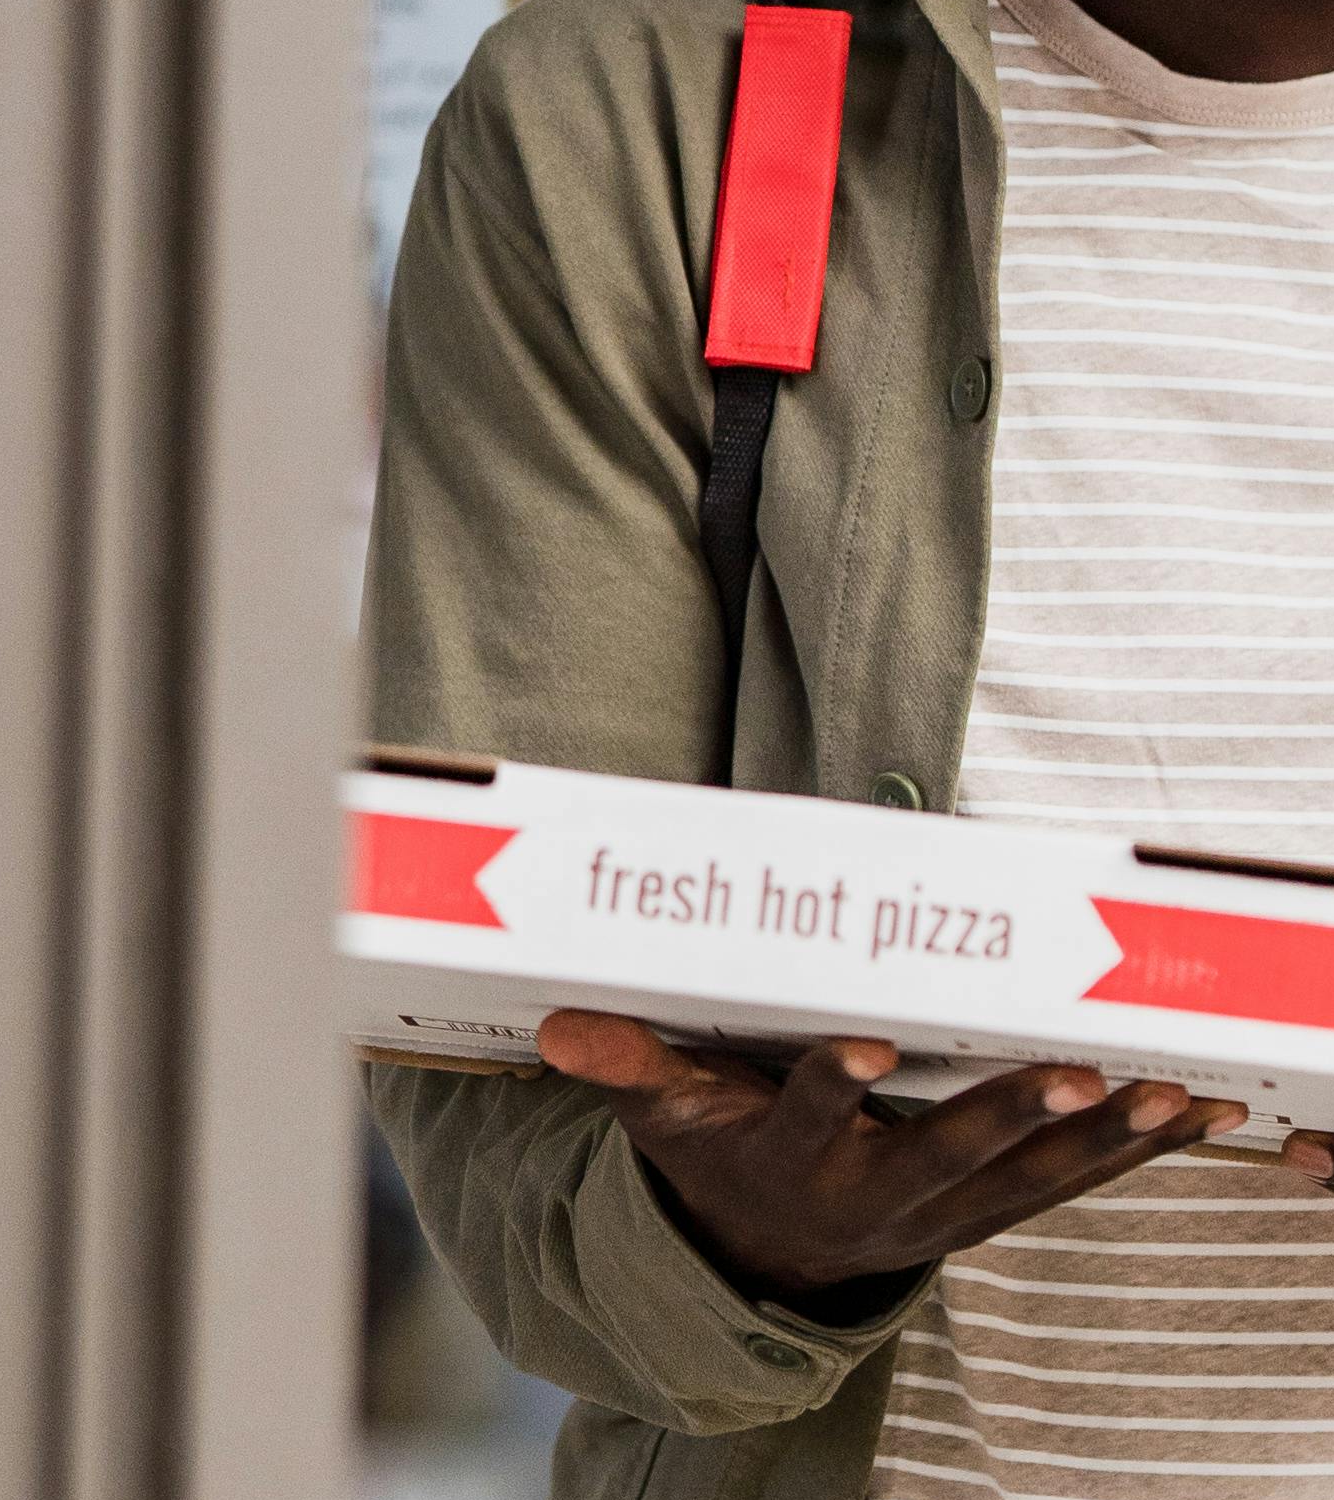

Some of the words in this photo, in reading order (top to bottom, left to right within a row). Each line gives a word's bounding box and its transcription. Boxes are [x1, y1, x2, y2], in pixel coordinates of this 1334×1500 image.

[587, 845, 732, 928] fresh
[756, 865, 850, 942] hot
[869, 882, 1015, 961] pizza
